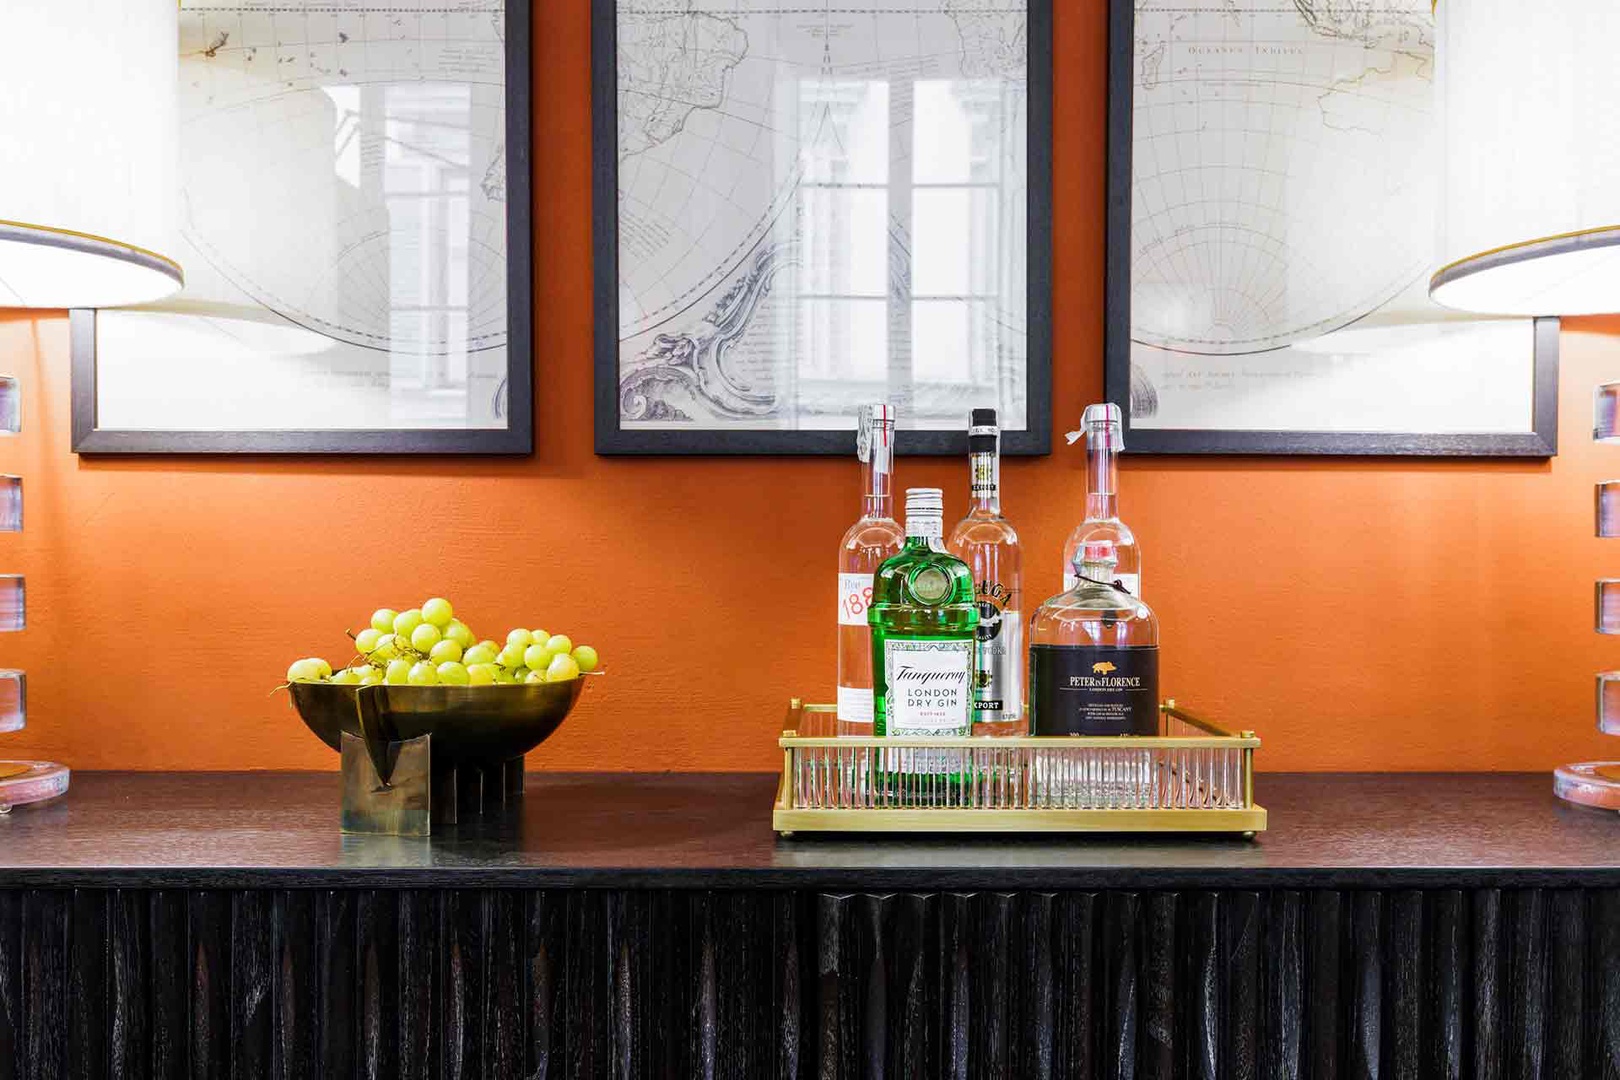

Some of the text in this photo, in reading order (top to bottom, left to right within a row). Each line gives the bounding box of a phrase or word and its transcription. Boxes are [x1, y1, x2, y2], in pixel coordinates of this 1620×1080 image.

[897, 665, 966, 685] Tanqueray
[908, 688, 957, 698] LONDON
[907, 698, 957, 707] DRY GIN
